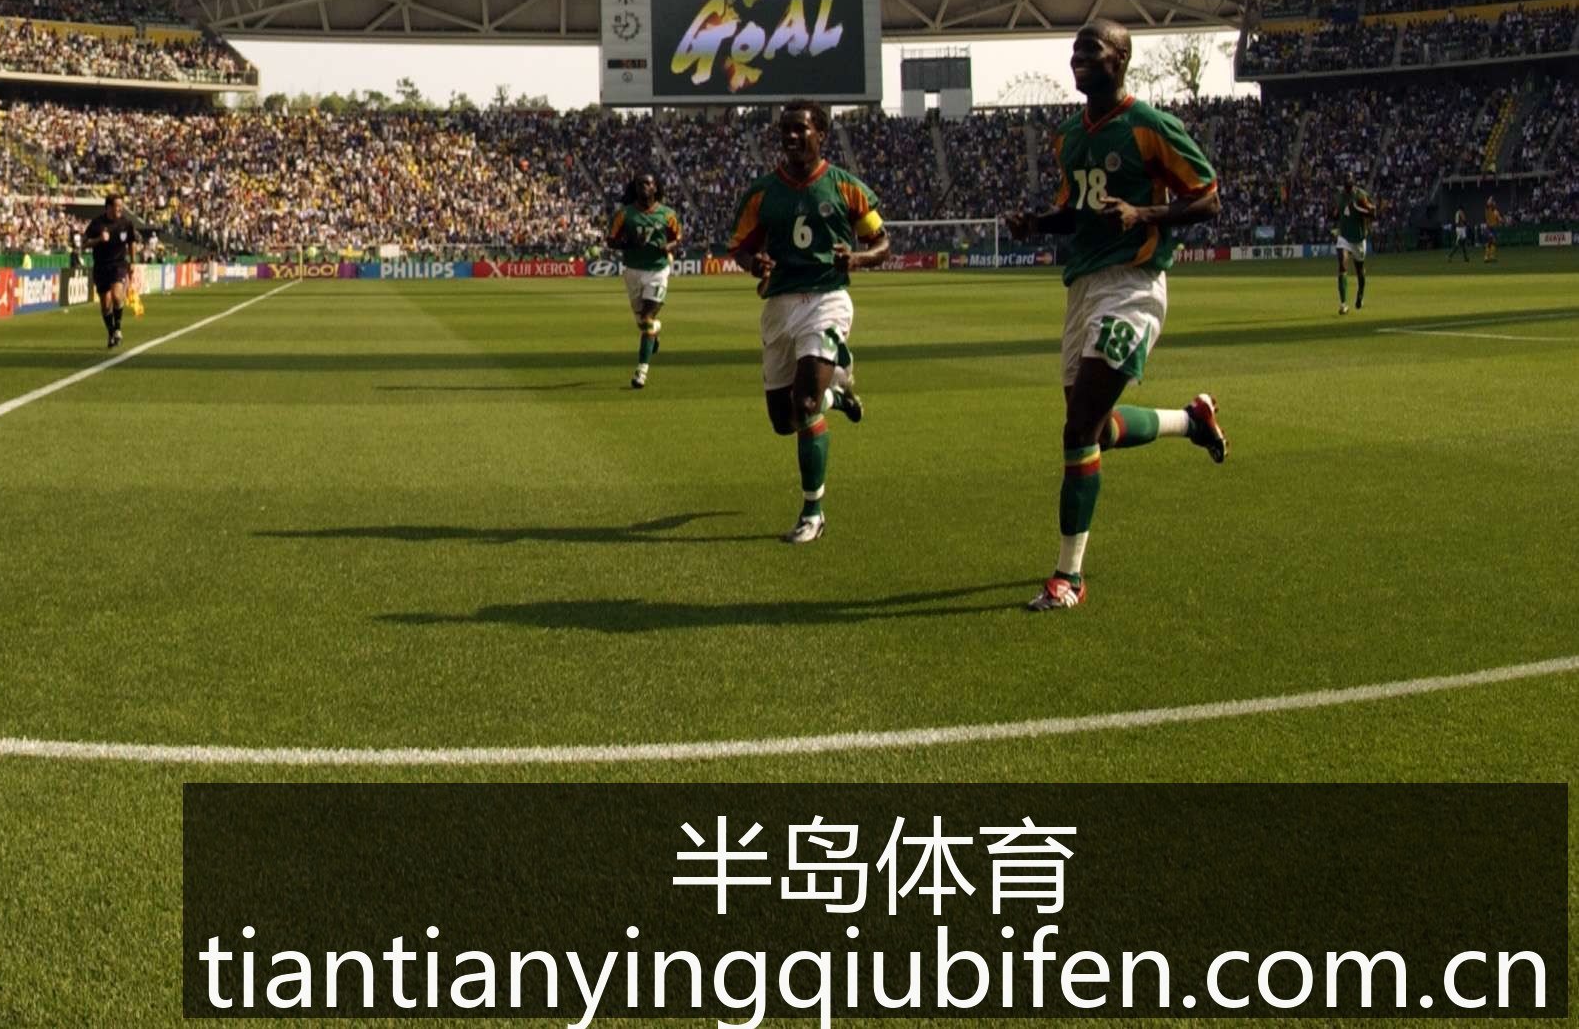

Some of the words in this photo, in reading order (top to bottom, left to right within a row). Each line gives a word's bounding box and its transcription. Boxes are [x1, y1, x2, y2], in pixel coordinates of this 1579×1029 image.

[1073, 170, 1108, 210] 18
[793, 216, 813, 249] 6
[534, 261, 577, 276] XEROX
[970, 253, 1035, 267] MasterCard
[268, 263, 340, 279] YAHOO!
[380, 262, 455, 279] PHILIPS
[1094, 315, 1136, 363] 18
